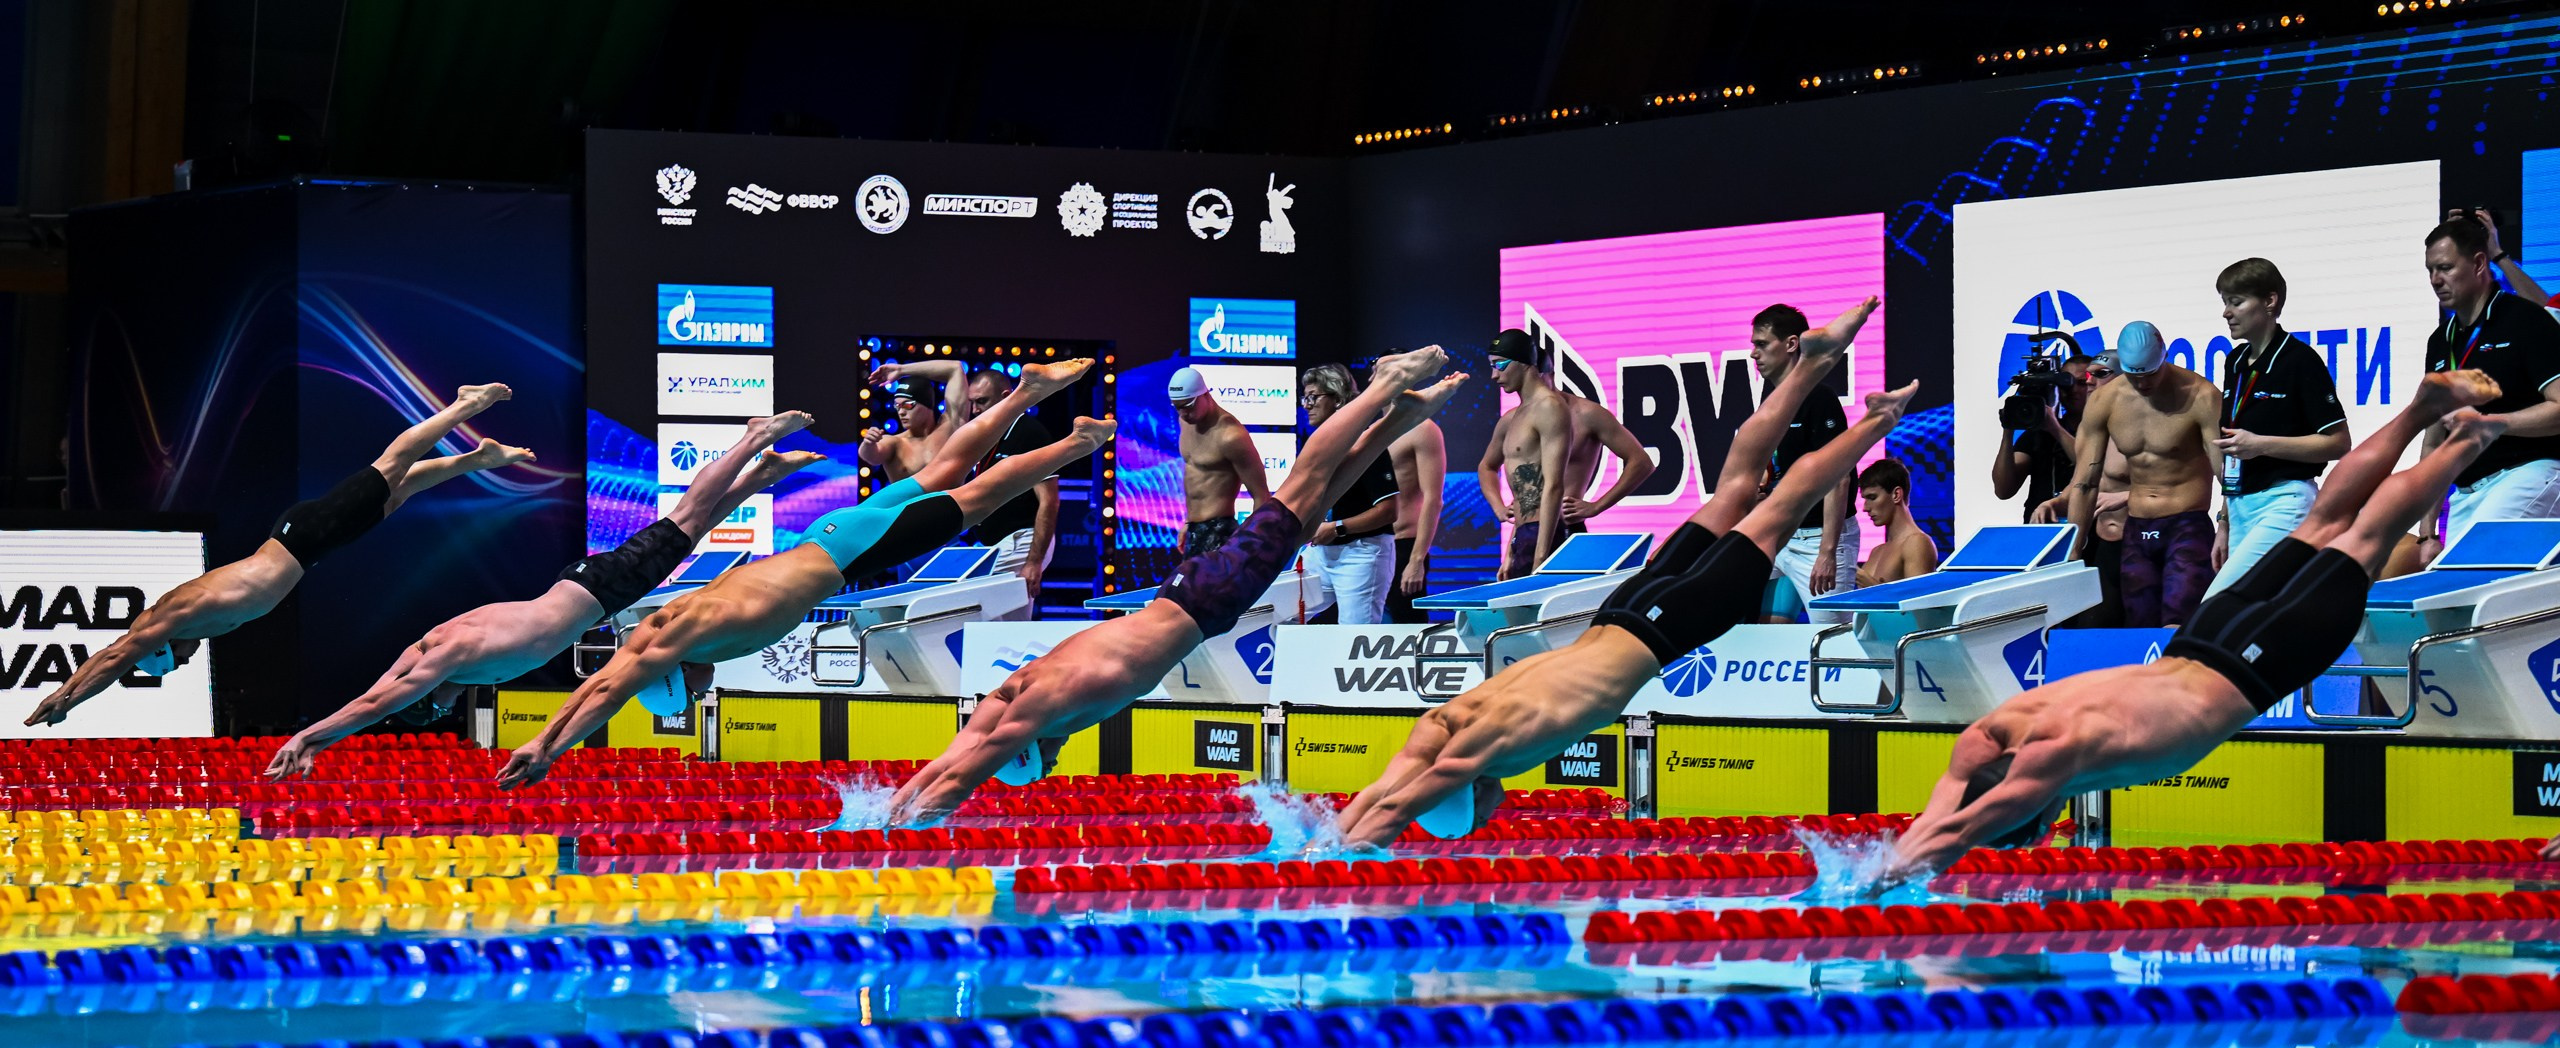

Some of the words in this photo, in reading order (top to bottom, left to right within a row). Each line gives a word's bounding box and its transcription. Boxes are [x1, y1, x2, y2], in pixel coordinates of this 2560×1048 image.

[787, 194, 839, 209] ФВВСР
[927, 197, 1034, 213] МИНСПОРТ
[1112, 219, 1158, 230] ПРОЕКТОВ
[696, 321, 765, 343] ГАЗПРОМ
[1225, 333, 1288, 354] ГАЗПРОМ
[688, 377, 766, 388] УРАЛХИМ
[1218, 387, 1289, 398] УРАЛХИМ
[2140, 530, 2160, 540] TYR
[1348, 635, 1459, 660] MAD
[1255, 642, 1275, 676] 2
[1723, 660, 1842, 682] РОССЕИ
[2023, 649, 2046, 687] 4
[1334, 667, 1468, 692] WAVE
[1915, 659, 1947, 702] 4
[2418, 669, 2458, 717] 5
[661, 716, 687, 729] WAVE
[733, 722, 755, 731] SWISS
[1209, 728, 1238, 745] MAD
[1206, 745, 1241, 763] WAVE
[1307, 742, 1336, 753] SWISS
[1337, 743, 1368, 754] TIMING
[1563, 741, 1598, 758] MAD
[1560, 760, 1601, 778] WAVE
[1680, 756, 1717, 769] SWISS
[1718, 758, 1755, 770] TIMING
[2138, 775, 2183, 787] WISS
[2185, 776, 2230, 789] TIMING
